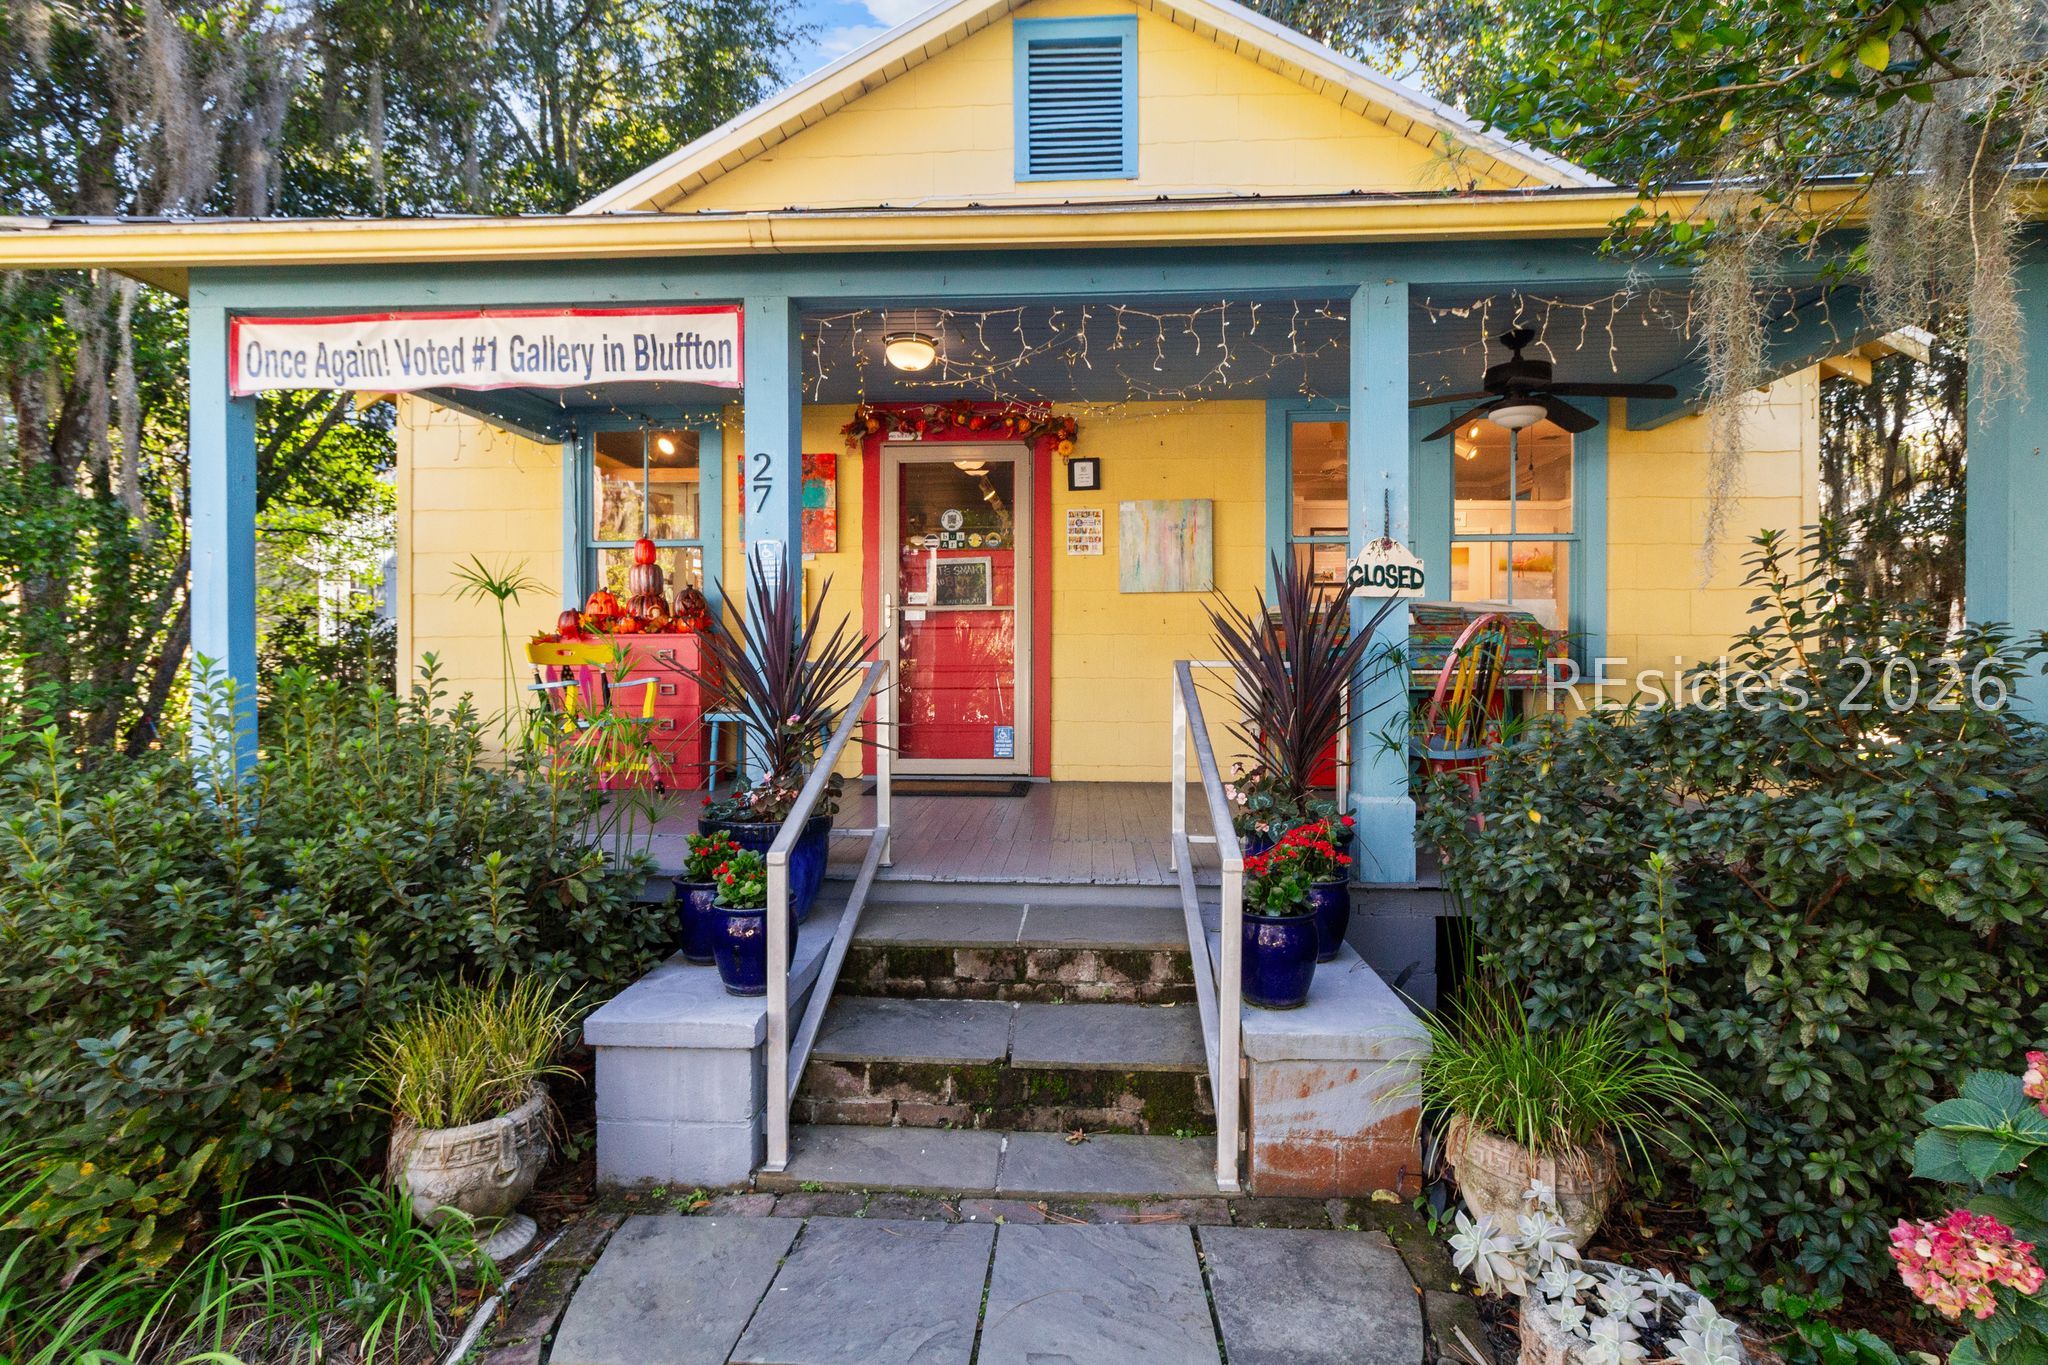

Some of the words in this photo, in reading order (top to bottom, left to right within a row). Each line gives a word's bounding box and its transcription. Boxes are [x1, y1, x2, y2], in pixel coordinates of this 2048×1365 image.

[246, 340, 307, 378] Once
[315, 338, 391, 386] Again!
[395, 337, 465, 376] Voted
[472, 336, 497, 373] #1
[510, 335, 594, 381] Gallery
[603, 334, 625, 372] in
[633, 332, 732, 372] Bluffton
[1348, 564, 1425, 590] CLOSED
